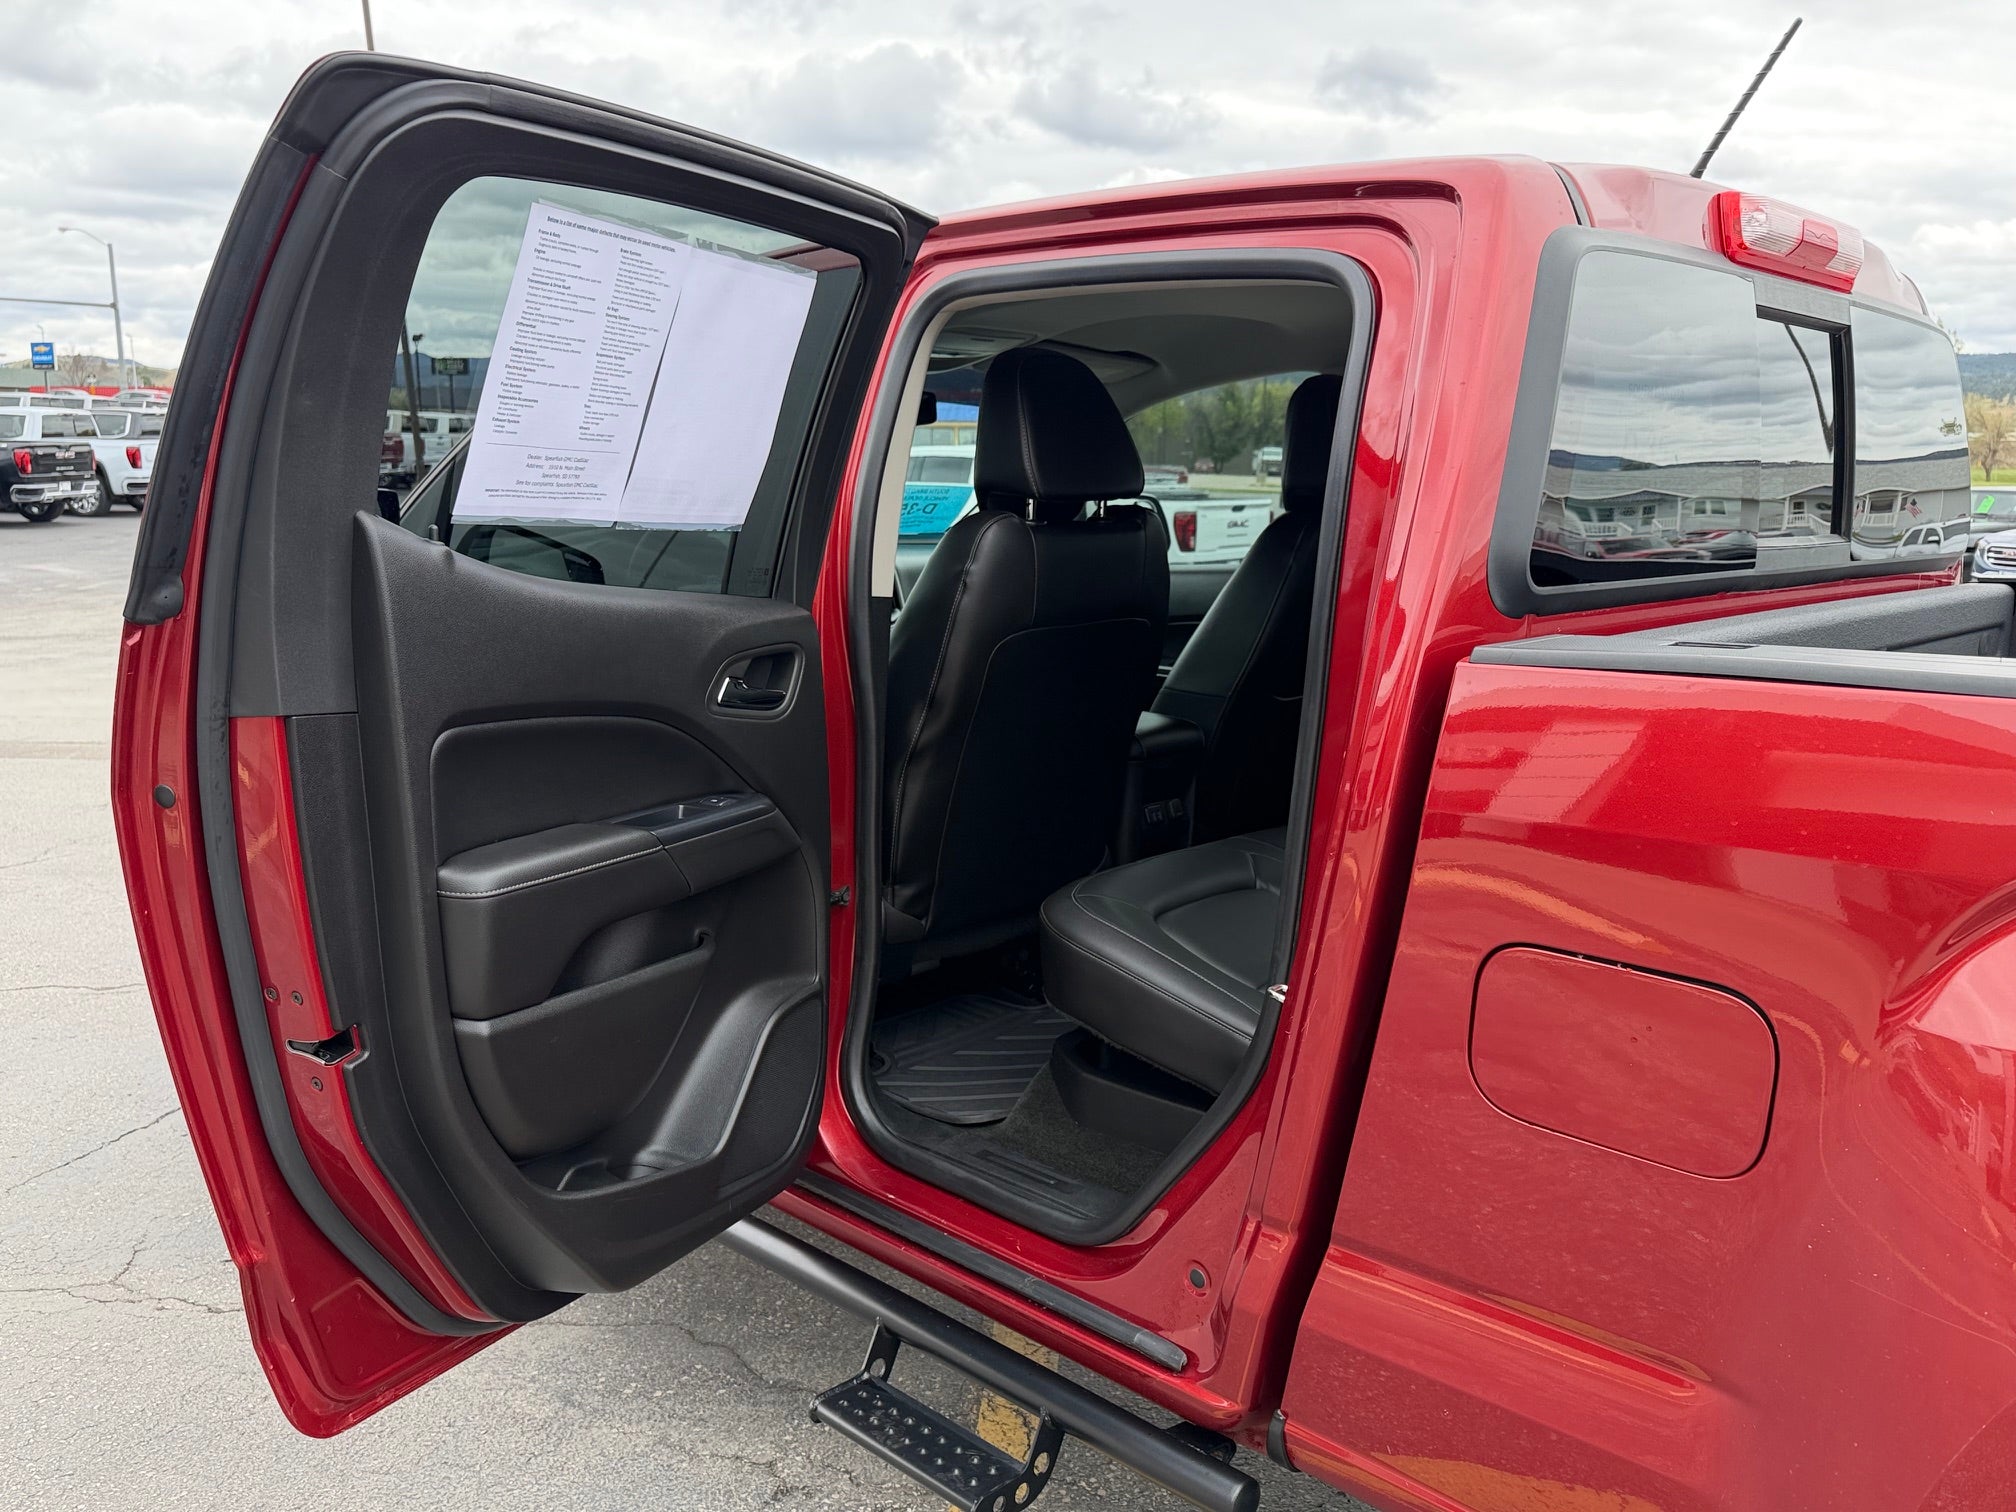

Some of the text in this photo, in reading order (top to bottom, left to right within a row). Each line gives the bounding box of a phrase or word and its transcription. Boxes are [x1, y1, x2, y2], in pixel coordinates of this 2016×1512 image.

[587, 226, 599, 234] major
[516, 321, 536, 329] Differential
[1227, 520, 1250, 529] GMC
